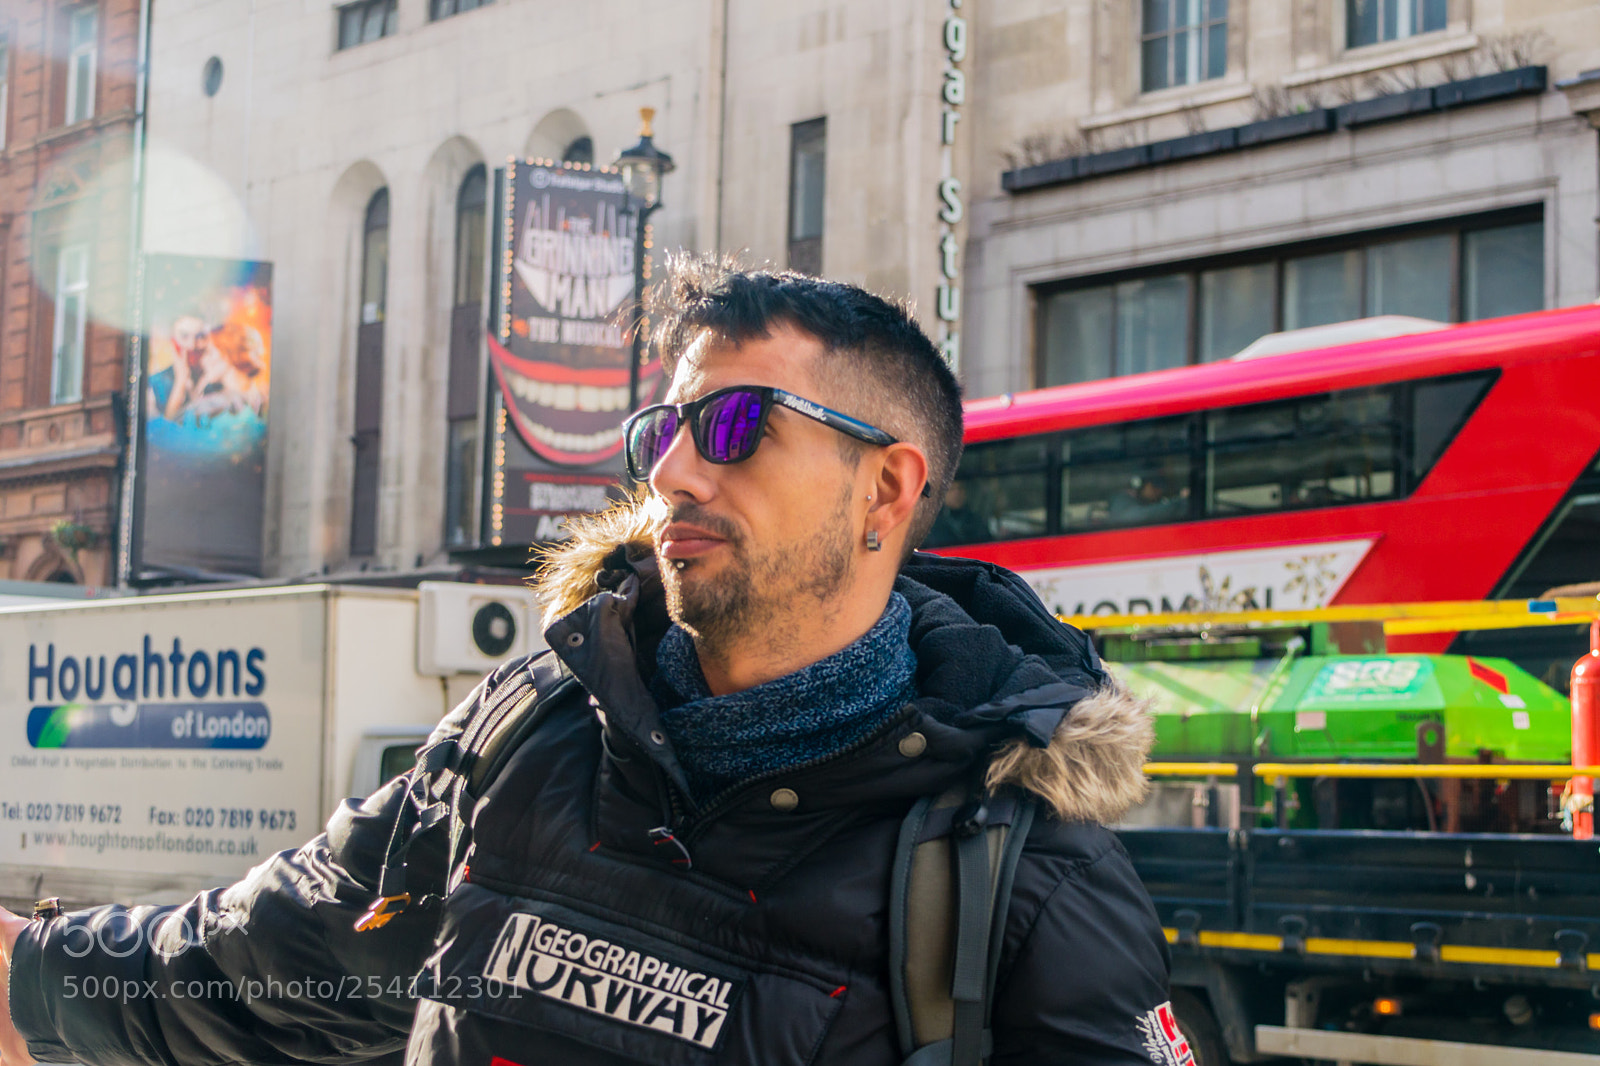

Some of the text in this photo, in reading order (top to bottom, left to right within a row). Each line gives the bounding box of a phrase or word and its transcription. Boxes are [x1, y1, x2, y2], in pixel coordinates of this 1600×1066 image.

[943, 0, 967, 146] gar
[522, 228, 637, 275] GRINNING
[548, 272, 610, 319] MAN
[28, 633, 267, 727] Houghtons
[171, 709, 268, 738] of London
[27, 803, 52, 821] 020
[56, 803, 86, 822] 7819
[90, 804, 122, 824] 9672
[150, 806, 297, 831] Fax: 020 7819 9673
[33, 829, 259, 857] www.houghtonsoflondon.co.uk
[486, 913, 722, 1044] NORWAY
[534, 923, 733, 1010] GEOGRAPHICAL
